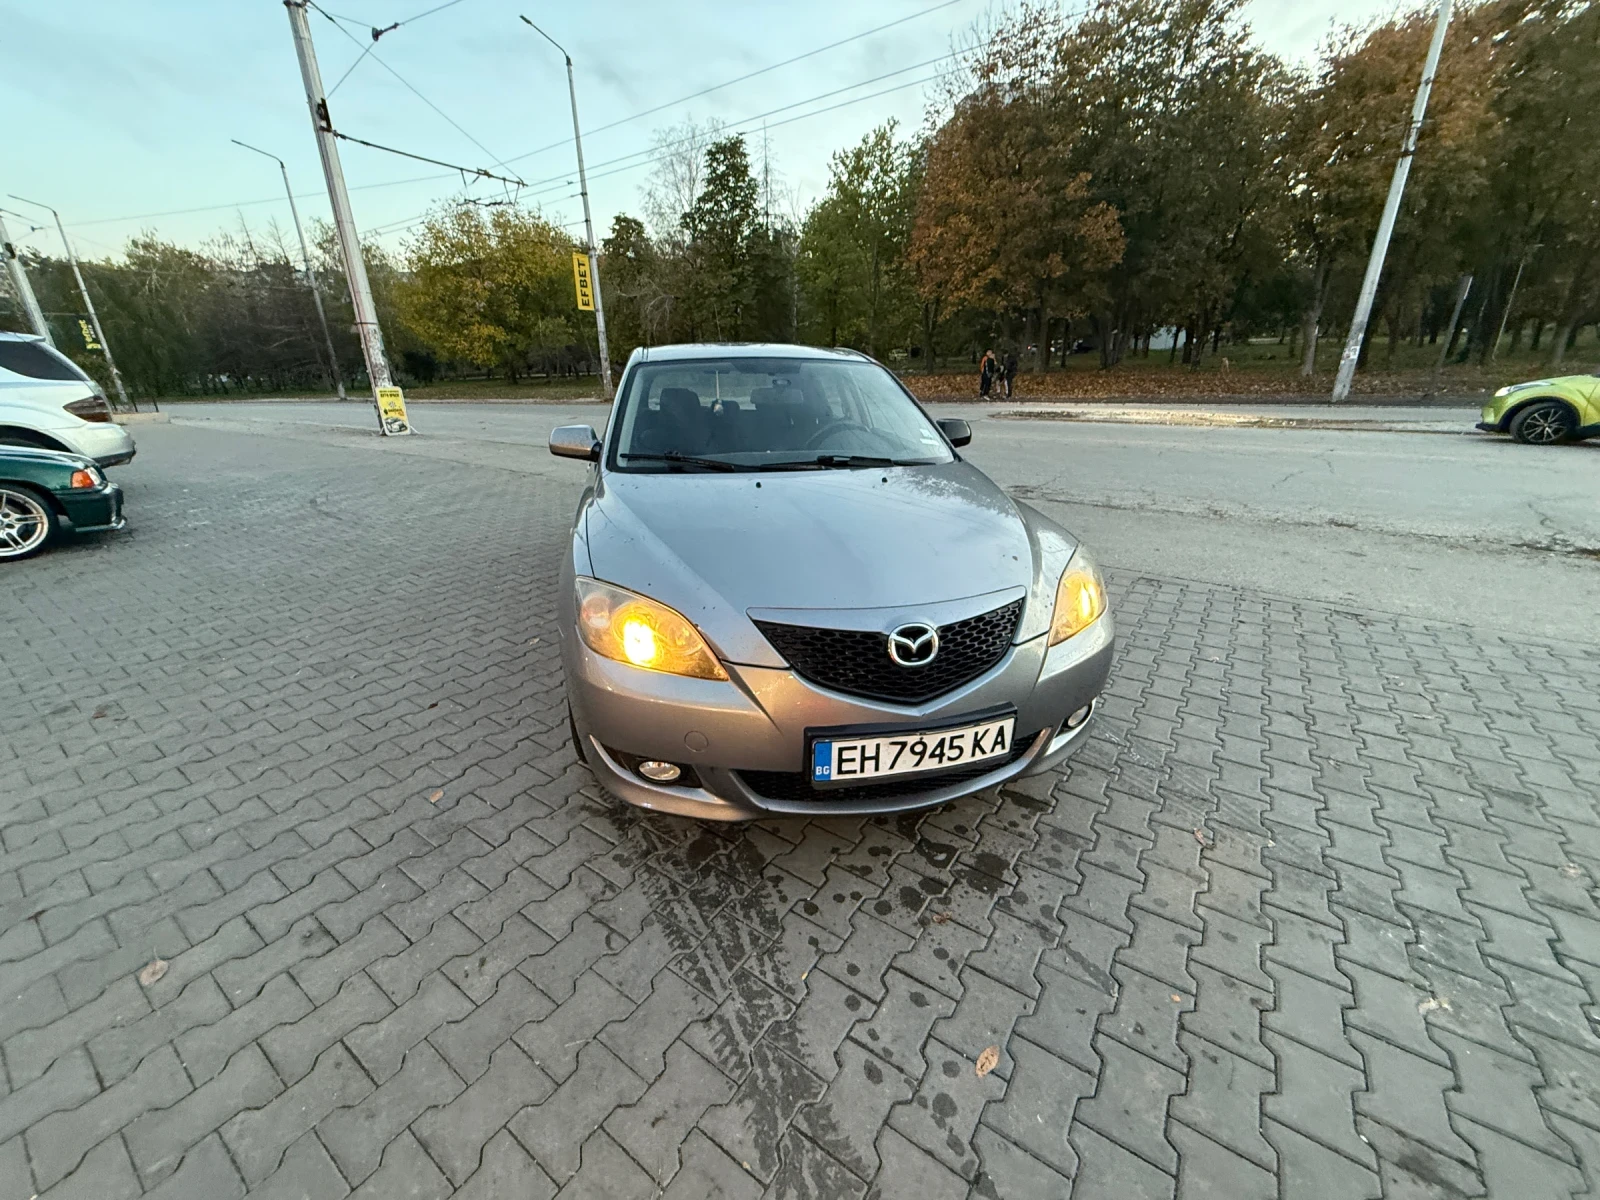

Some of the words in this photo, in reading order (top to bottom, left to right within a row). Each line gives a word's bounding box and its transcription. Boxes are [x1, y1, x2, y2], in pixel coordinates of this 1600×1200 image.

[577, 258, 590, 307] EFBET
[815, 765, 830, 775] BG
[837, 742, 881, 775] EH
[888, 734, 965, 770] 7945
[971, 725, 1006, 757] KA
